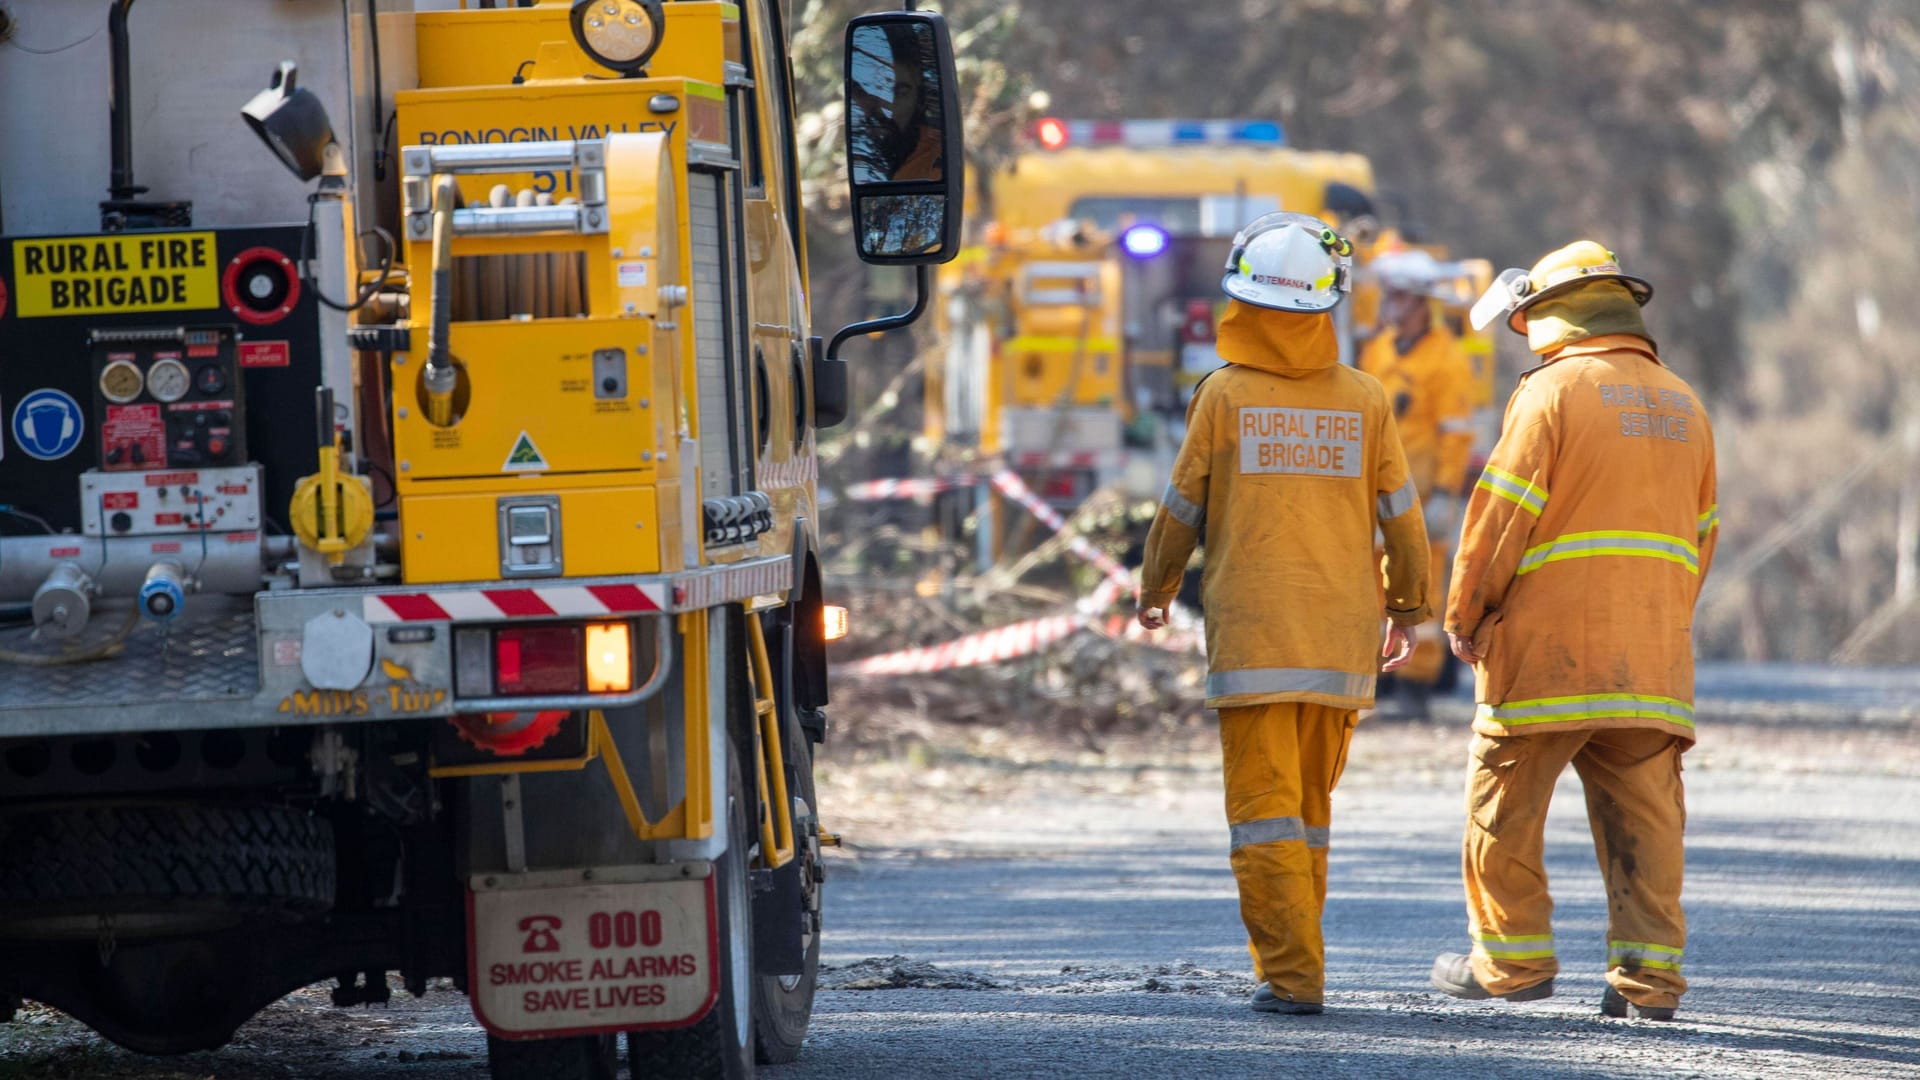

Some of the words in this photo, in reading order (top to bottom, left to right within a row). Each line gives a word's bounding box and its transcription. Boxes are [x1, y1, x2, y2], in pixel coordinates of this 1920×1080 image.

[420, 127, 557, 145] BONOGIN
[533, 170, 572, 194] 51
[24, 241, 128, 275] RURAL
[141, 238, 207, 270] FIRE
[51, 275, 187, 309] BRIGADE
[1266, 276, 1305, 289] TEMANA
[1599, 384, 1657, 409] RURAL
[1658, 388, 1696, 416] FIRE
[1243, 413, 1310, 438] RURAL
[1315, 415, 1360, 441] FIRE
[1620, 412, 1689, 442] SERVICE
[1258, 443, 1345, 470] BRIGADE
[588, 910, 663, 949] 000
[490, 960, 583, 986] SMOKE
[589, 954, 697, 981] ALARMS
[523, 989, 590, 1013] SAVE
[595, 984, 667, 1009] LIVES
